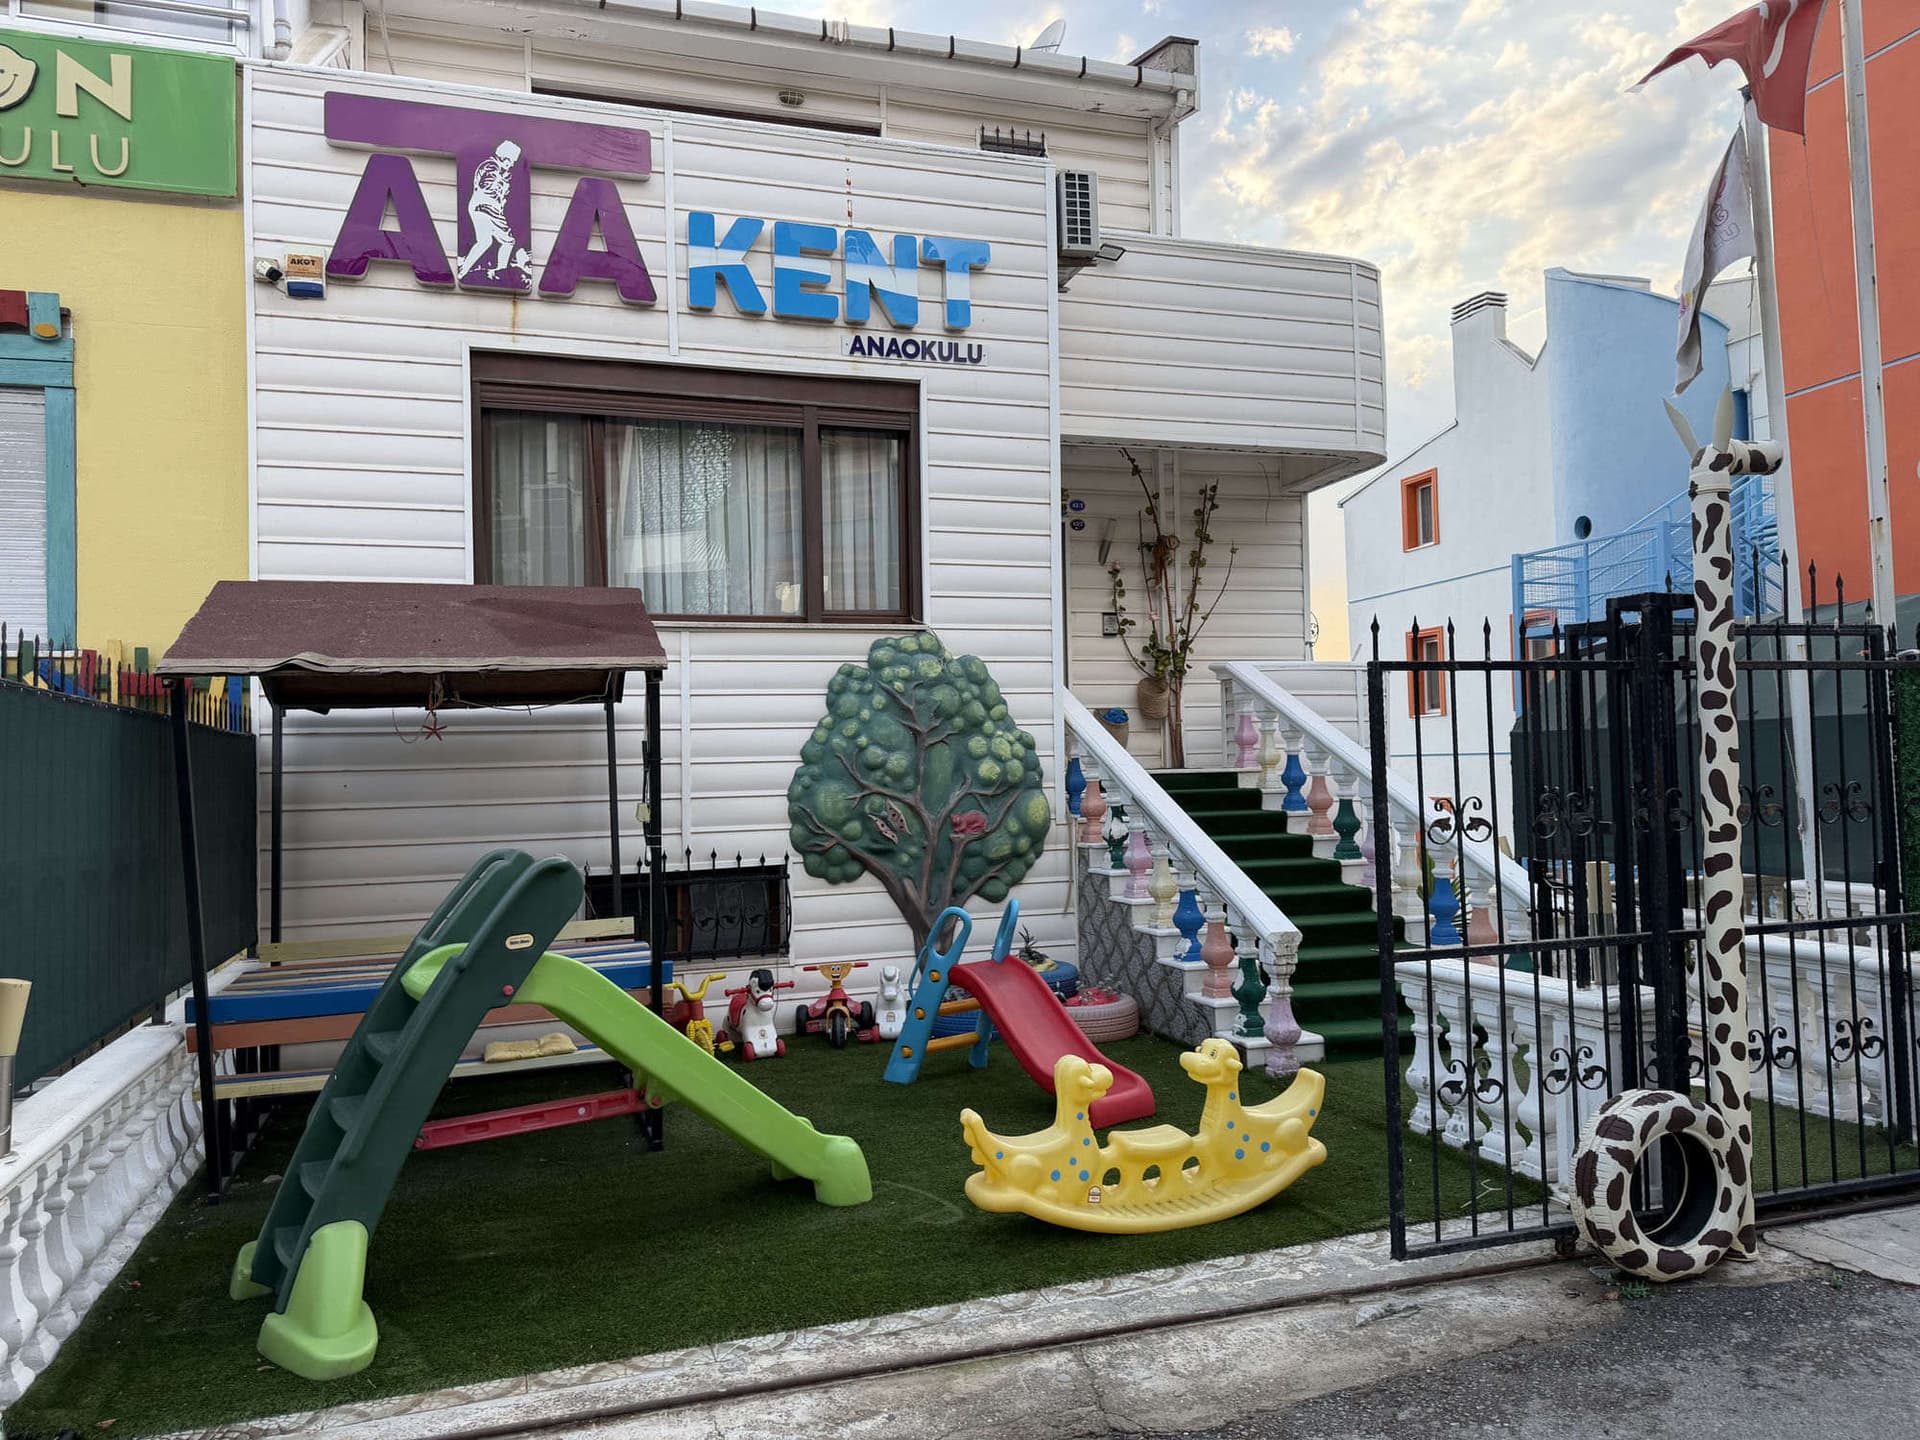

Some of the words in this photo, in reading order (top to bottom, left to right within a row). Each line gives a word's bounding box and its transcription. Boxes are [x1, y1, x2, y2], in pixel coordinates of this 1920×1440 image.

[324, 91, 657, 306] ATA
[687, 211, 991, 331] KENT
[849, 335, 983, 364] ANAOKULU
